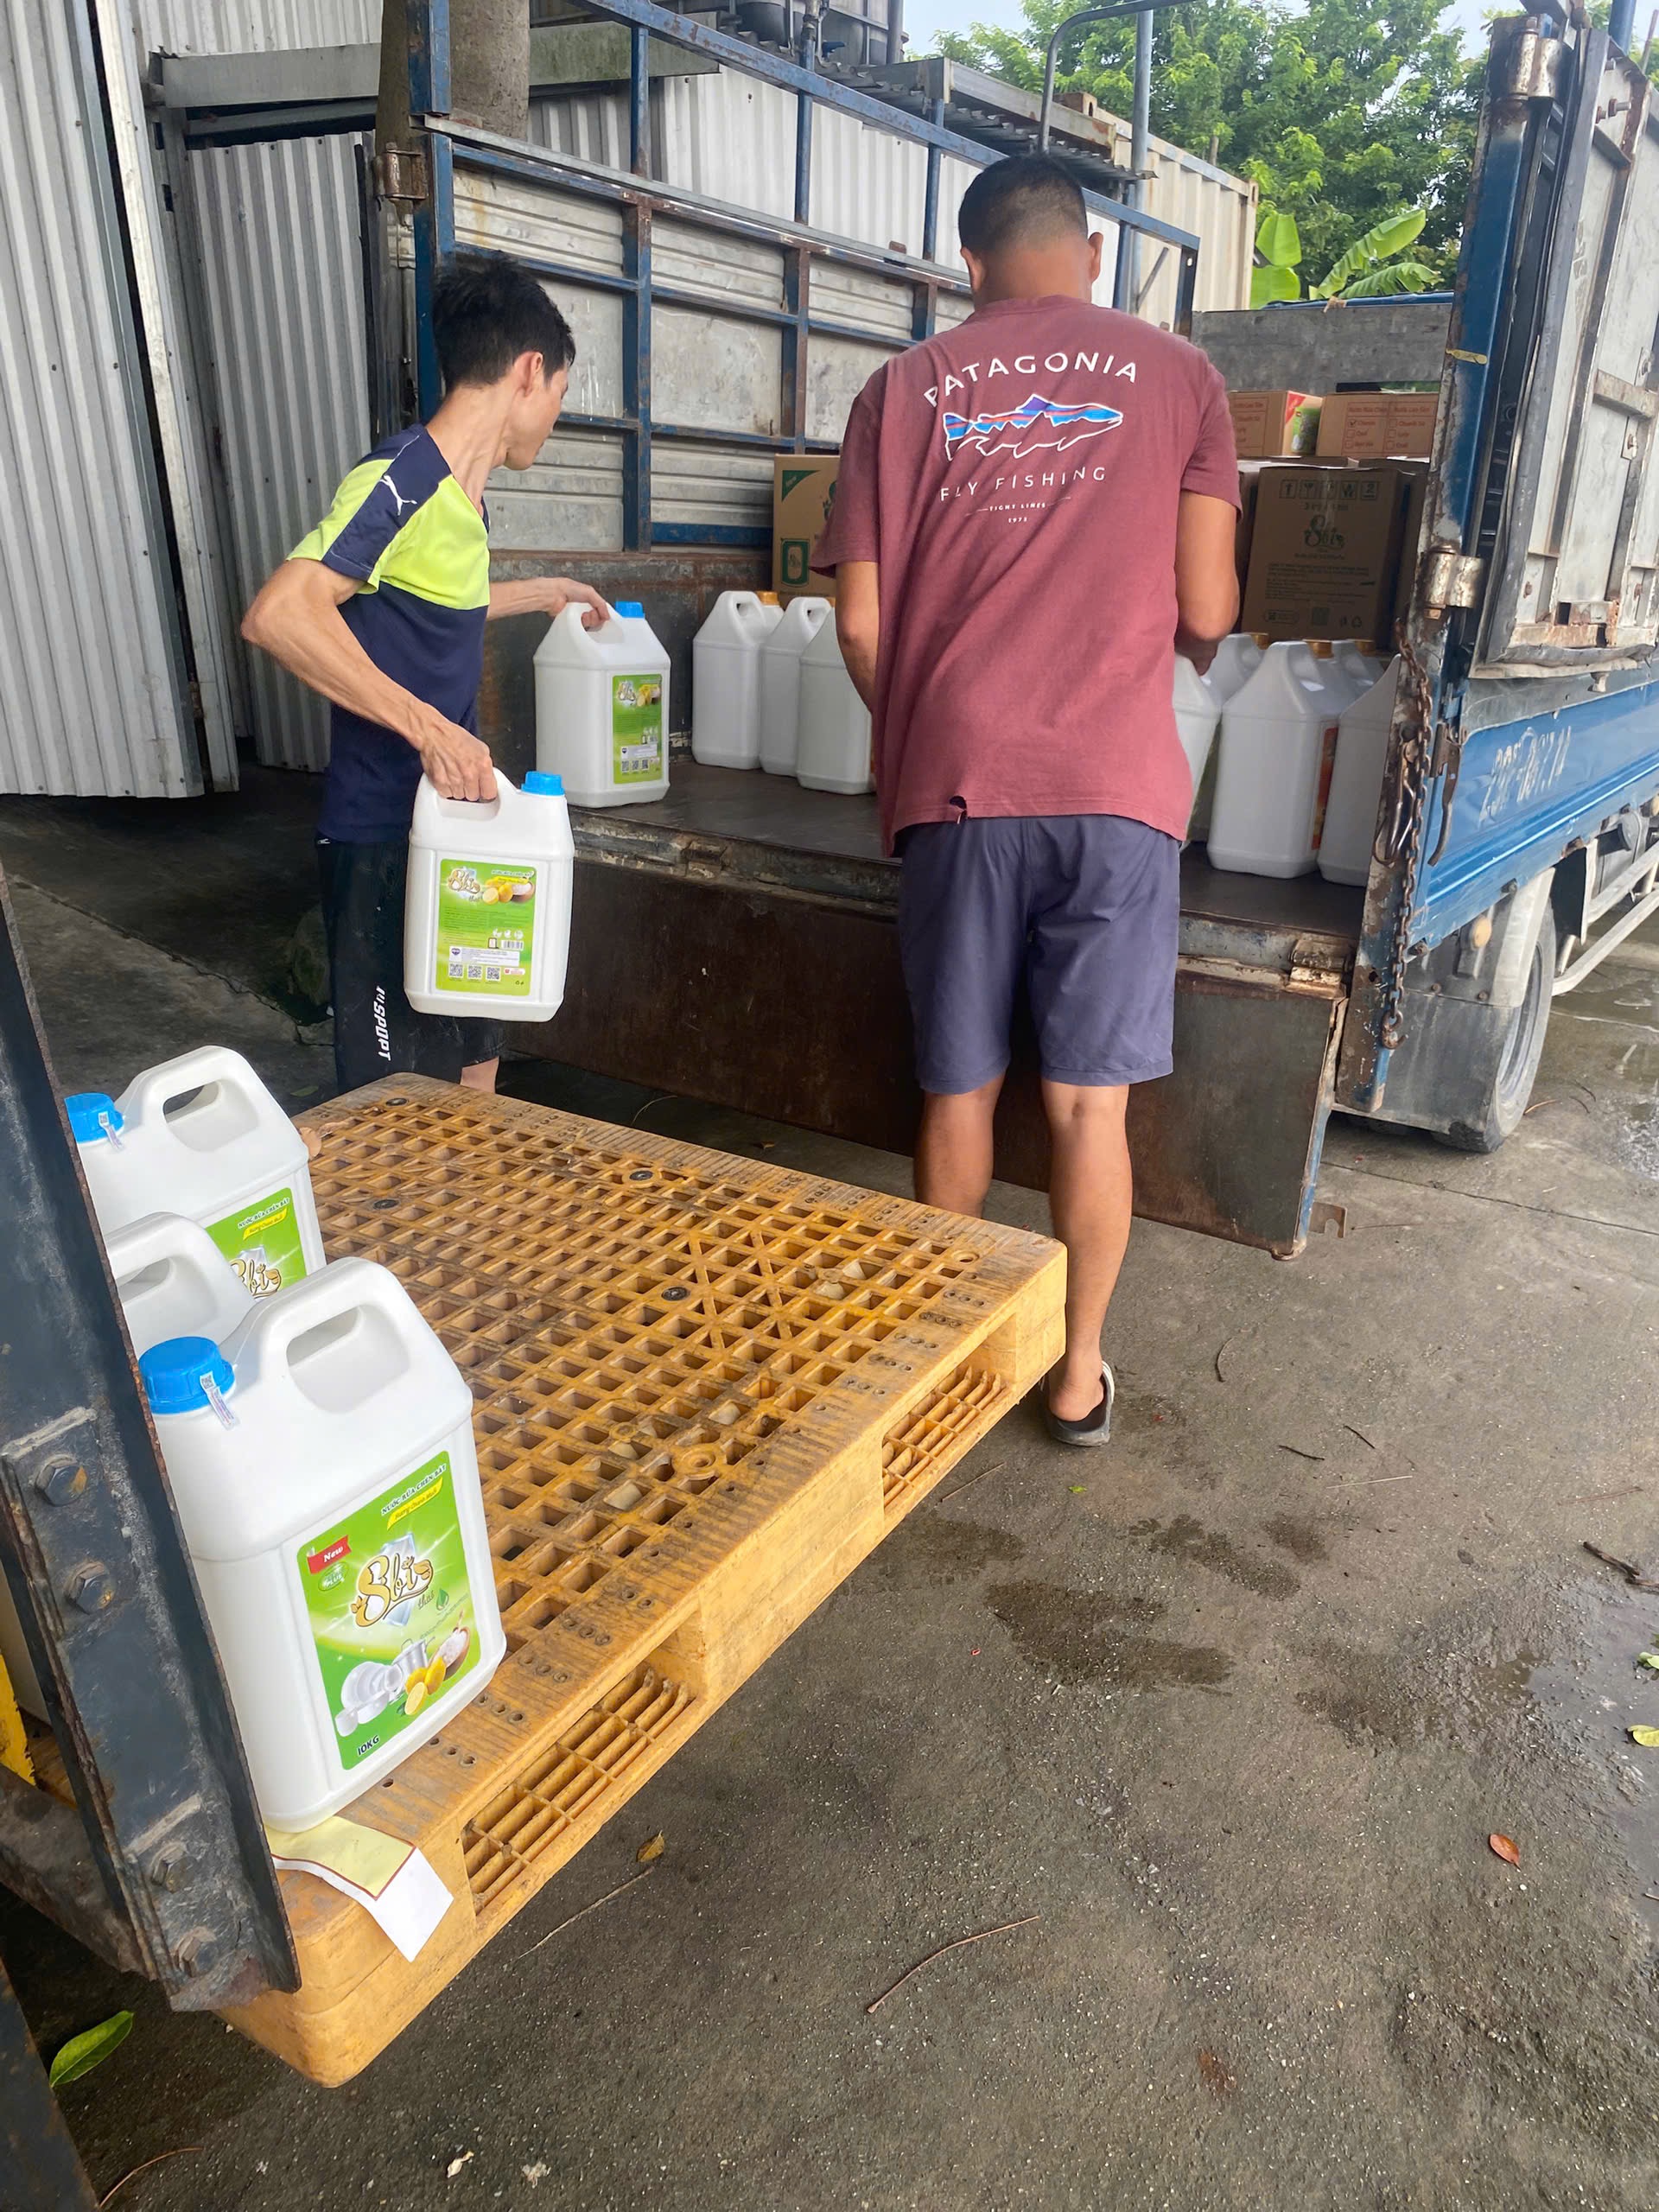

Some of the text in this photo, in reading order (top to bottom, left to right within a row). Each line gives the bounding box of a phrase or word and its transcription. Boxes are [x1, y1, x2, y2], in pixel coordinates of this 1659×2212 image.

[924, 352, 1136, 407] PATAGONIA
[940, 467, 1106, 501] FLY FISHING
[416, 1475, 433, 1490] CHÉN
[323, 1547, 343, 1562] New
